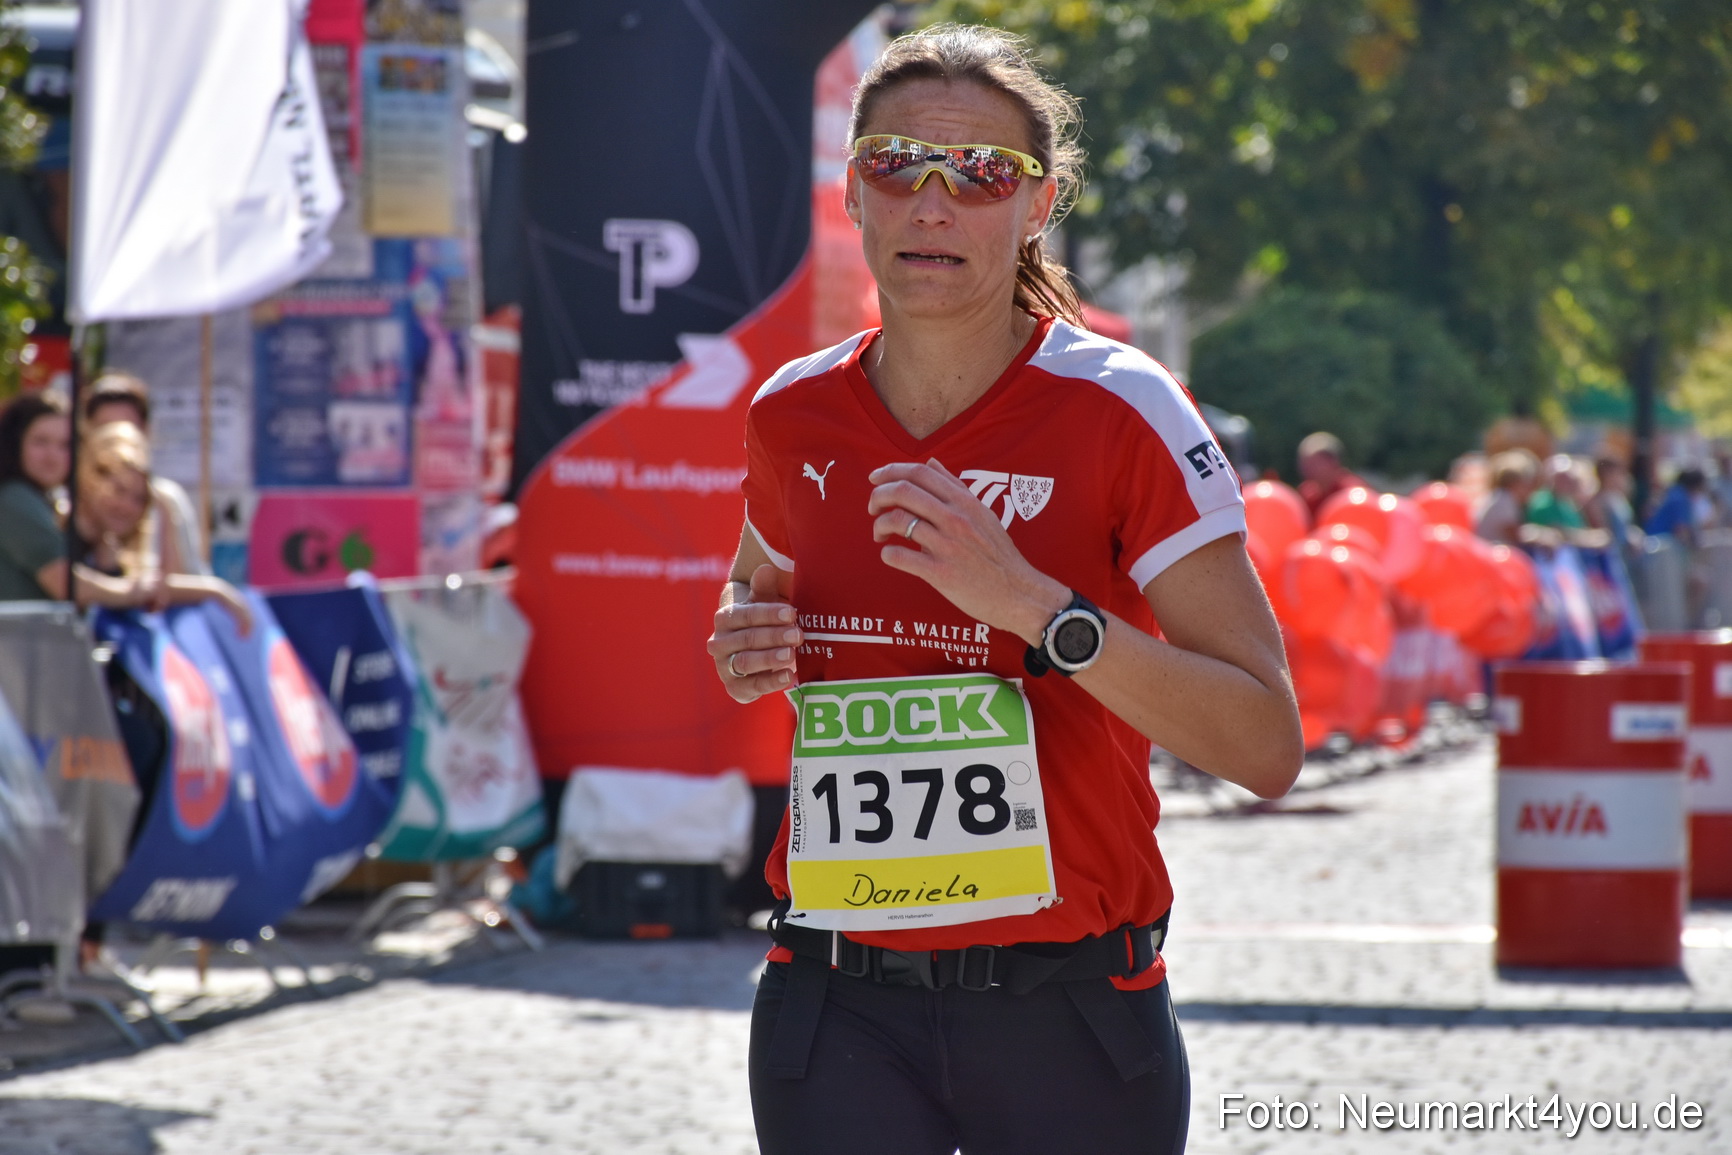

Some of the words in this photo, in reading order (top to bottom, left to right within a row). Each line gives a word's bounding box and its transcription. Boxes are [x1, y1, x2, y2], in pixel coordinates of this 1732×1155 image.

[893, 620, 904, 633] &
[913, 622, 990, 644] WALTER
[896, 637, 916, 646] DAS
[920, 639, 989, 655] HERRENHAUS
[945, 651, 989, 667] Lauf
[802, 685, 1008, 748] BOCK
[812, 764, 1011, 843] 1378
